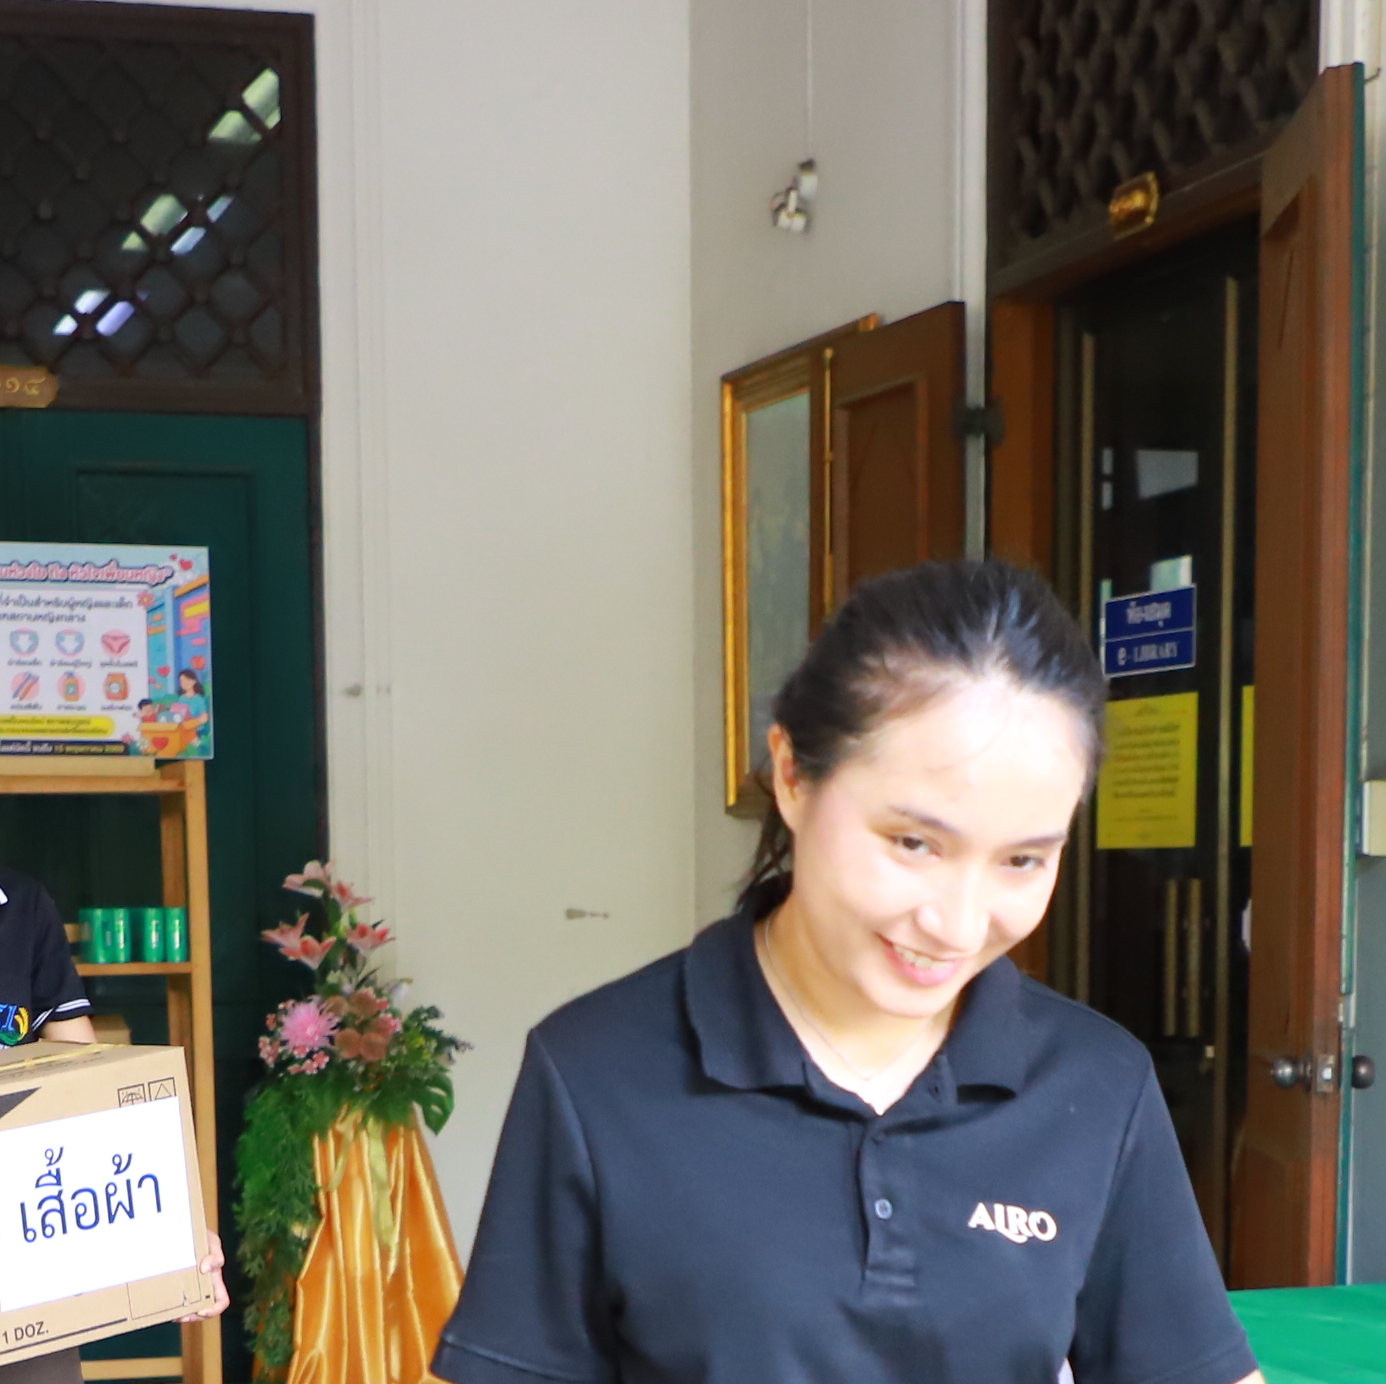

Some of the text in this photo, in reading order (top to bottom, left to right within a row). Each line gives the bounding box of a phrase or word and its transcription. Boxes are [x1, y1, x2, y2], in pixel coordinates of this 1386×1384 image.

[18, 1146, 163, 1244] เสื้อผ้า
[2, 1320, 49, 1344] 1 DOZ.
